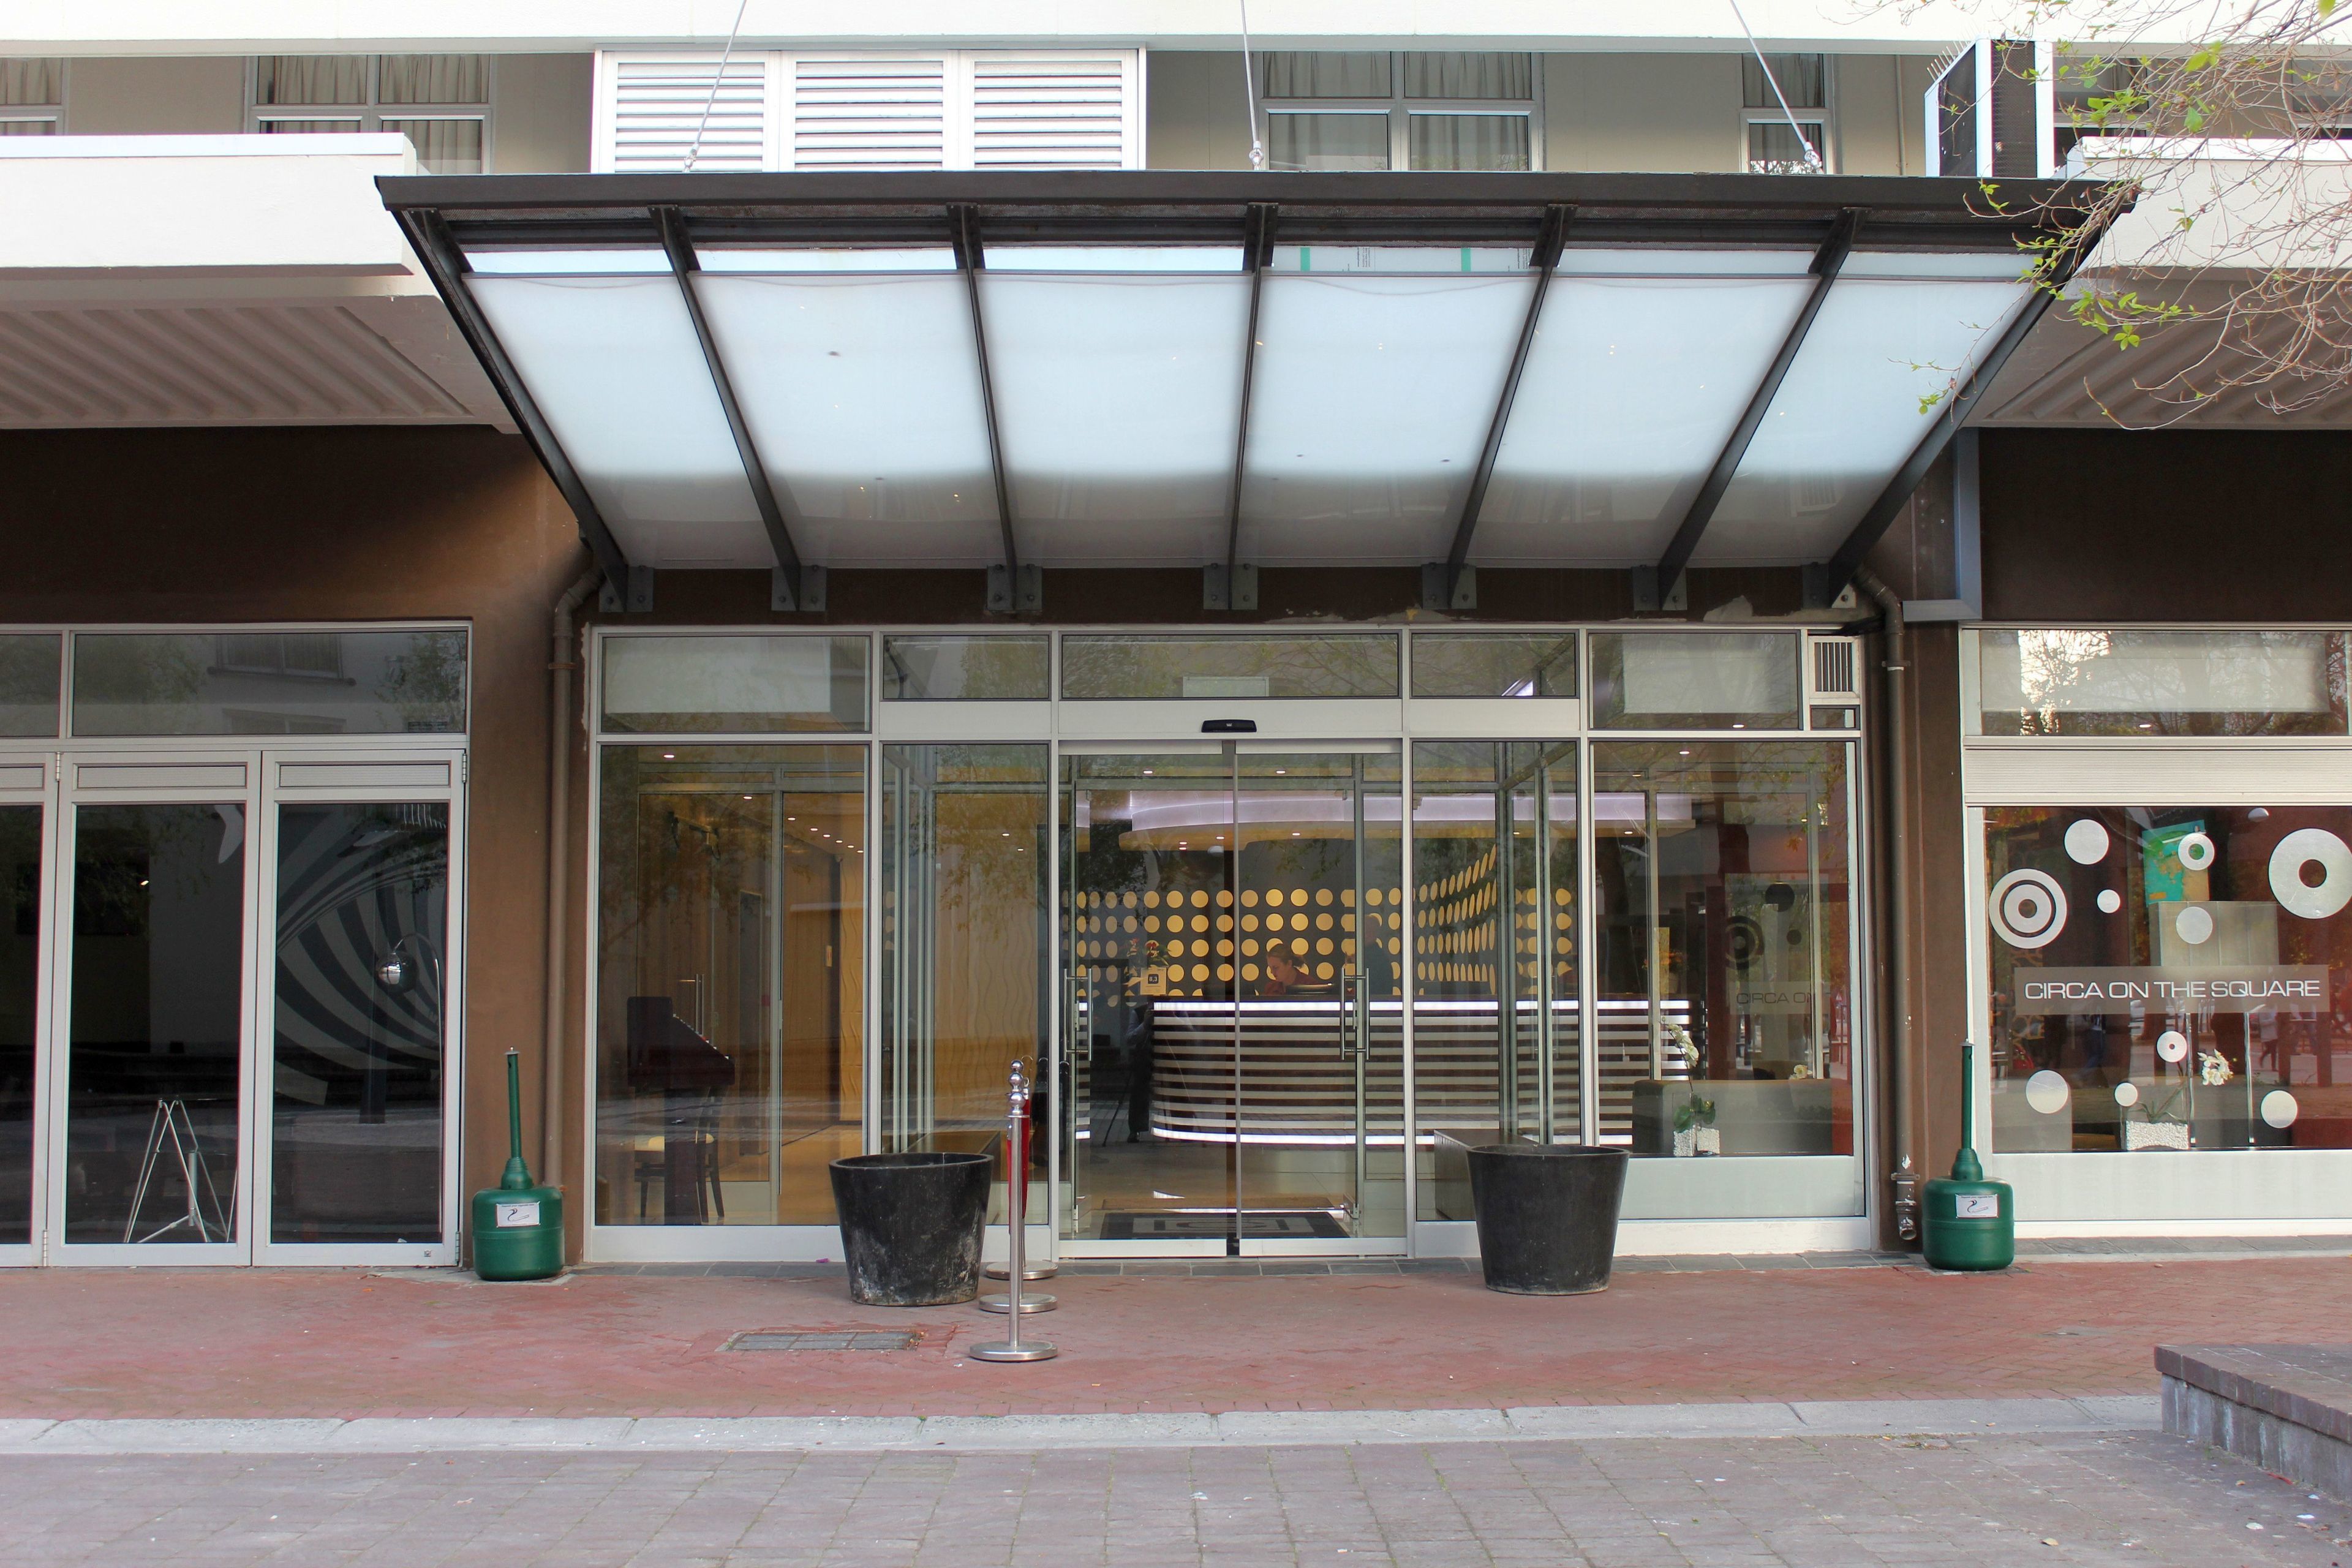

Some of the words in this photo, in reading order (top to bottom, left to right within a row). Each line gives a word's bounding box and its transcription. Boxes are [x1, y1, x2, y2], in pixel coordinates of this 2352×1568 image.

[2025, 982, 2103, 999] CIRCA
[2108, 981, 2148, 998] ON
[2154, 981, 2206, 998] THE
[2211, 980, 2320, 997] SQUARE
[1736, 992, 1789, 1004] CIRCA
